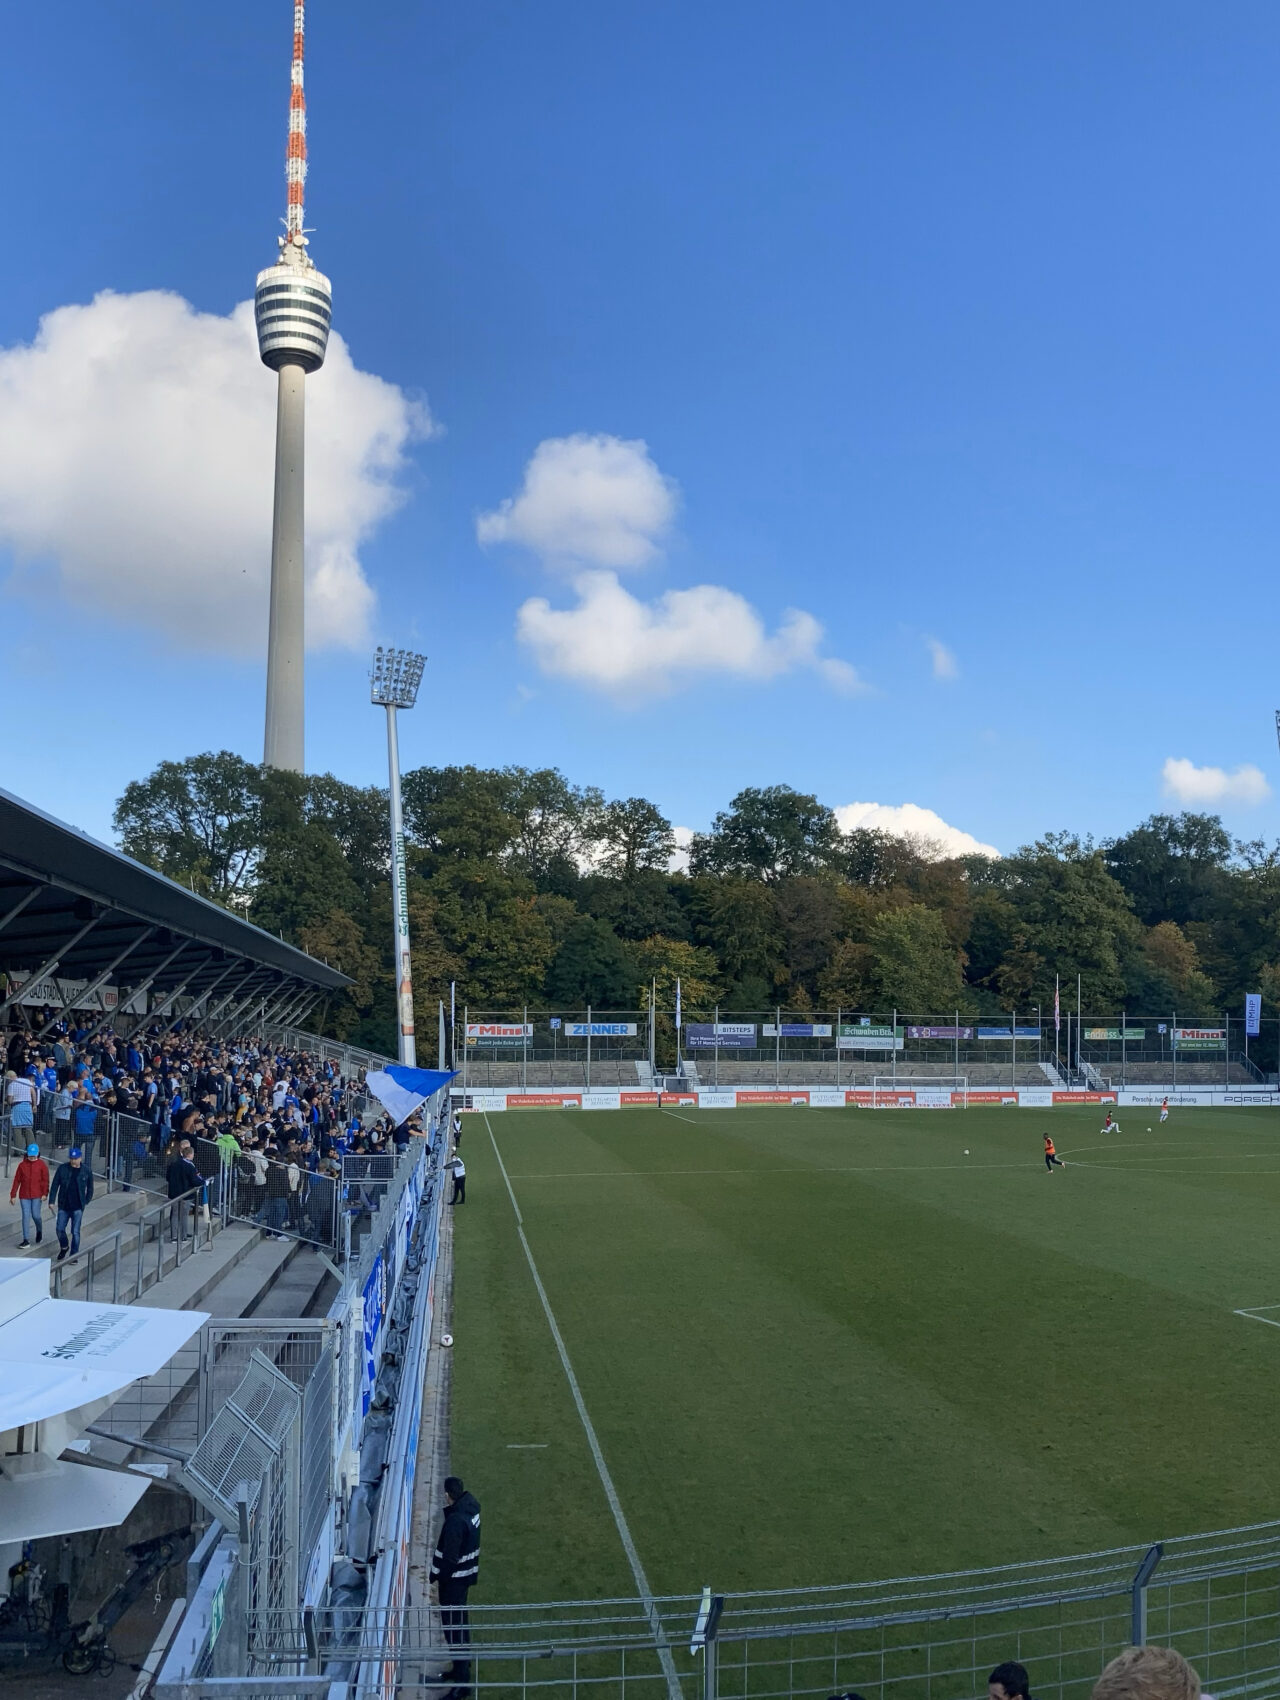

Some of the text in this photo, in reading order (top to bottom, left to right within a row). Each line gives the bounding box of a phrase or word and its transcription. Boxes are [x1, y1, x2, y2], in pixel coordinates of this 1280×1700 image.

[573, 1025, 628, 1034] ZENNER
[845, 1027, 878, 1036] Schwaben
[1085, 1030, 1117, 1039] endress
[1154, 1096, 1197, 1104] Jugdförderung
